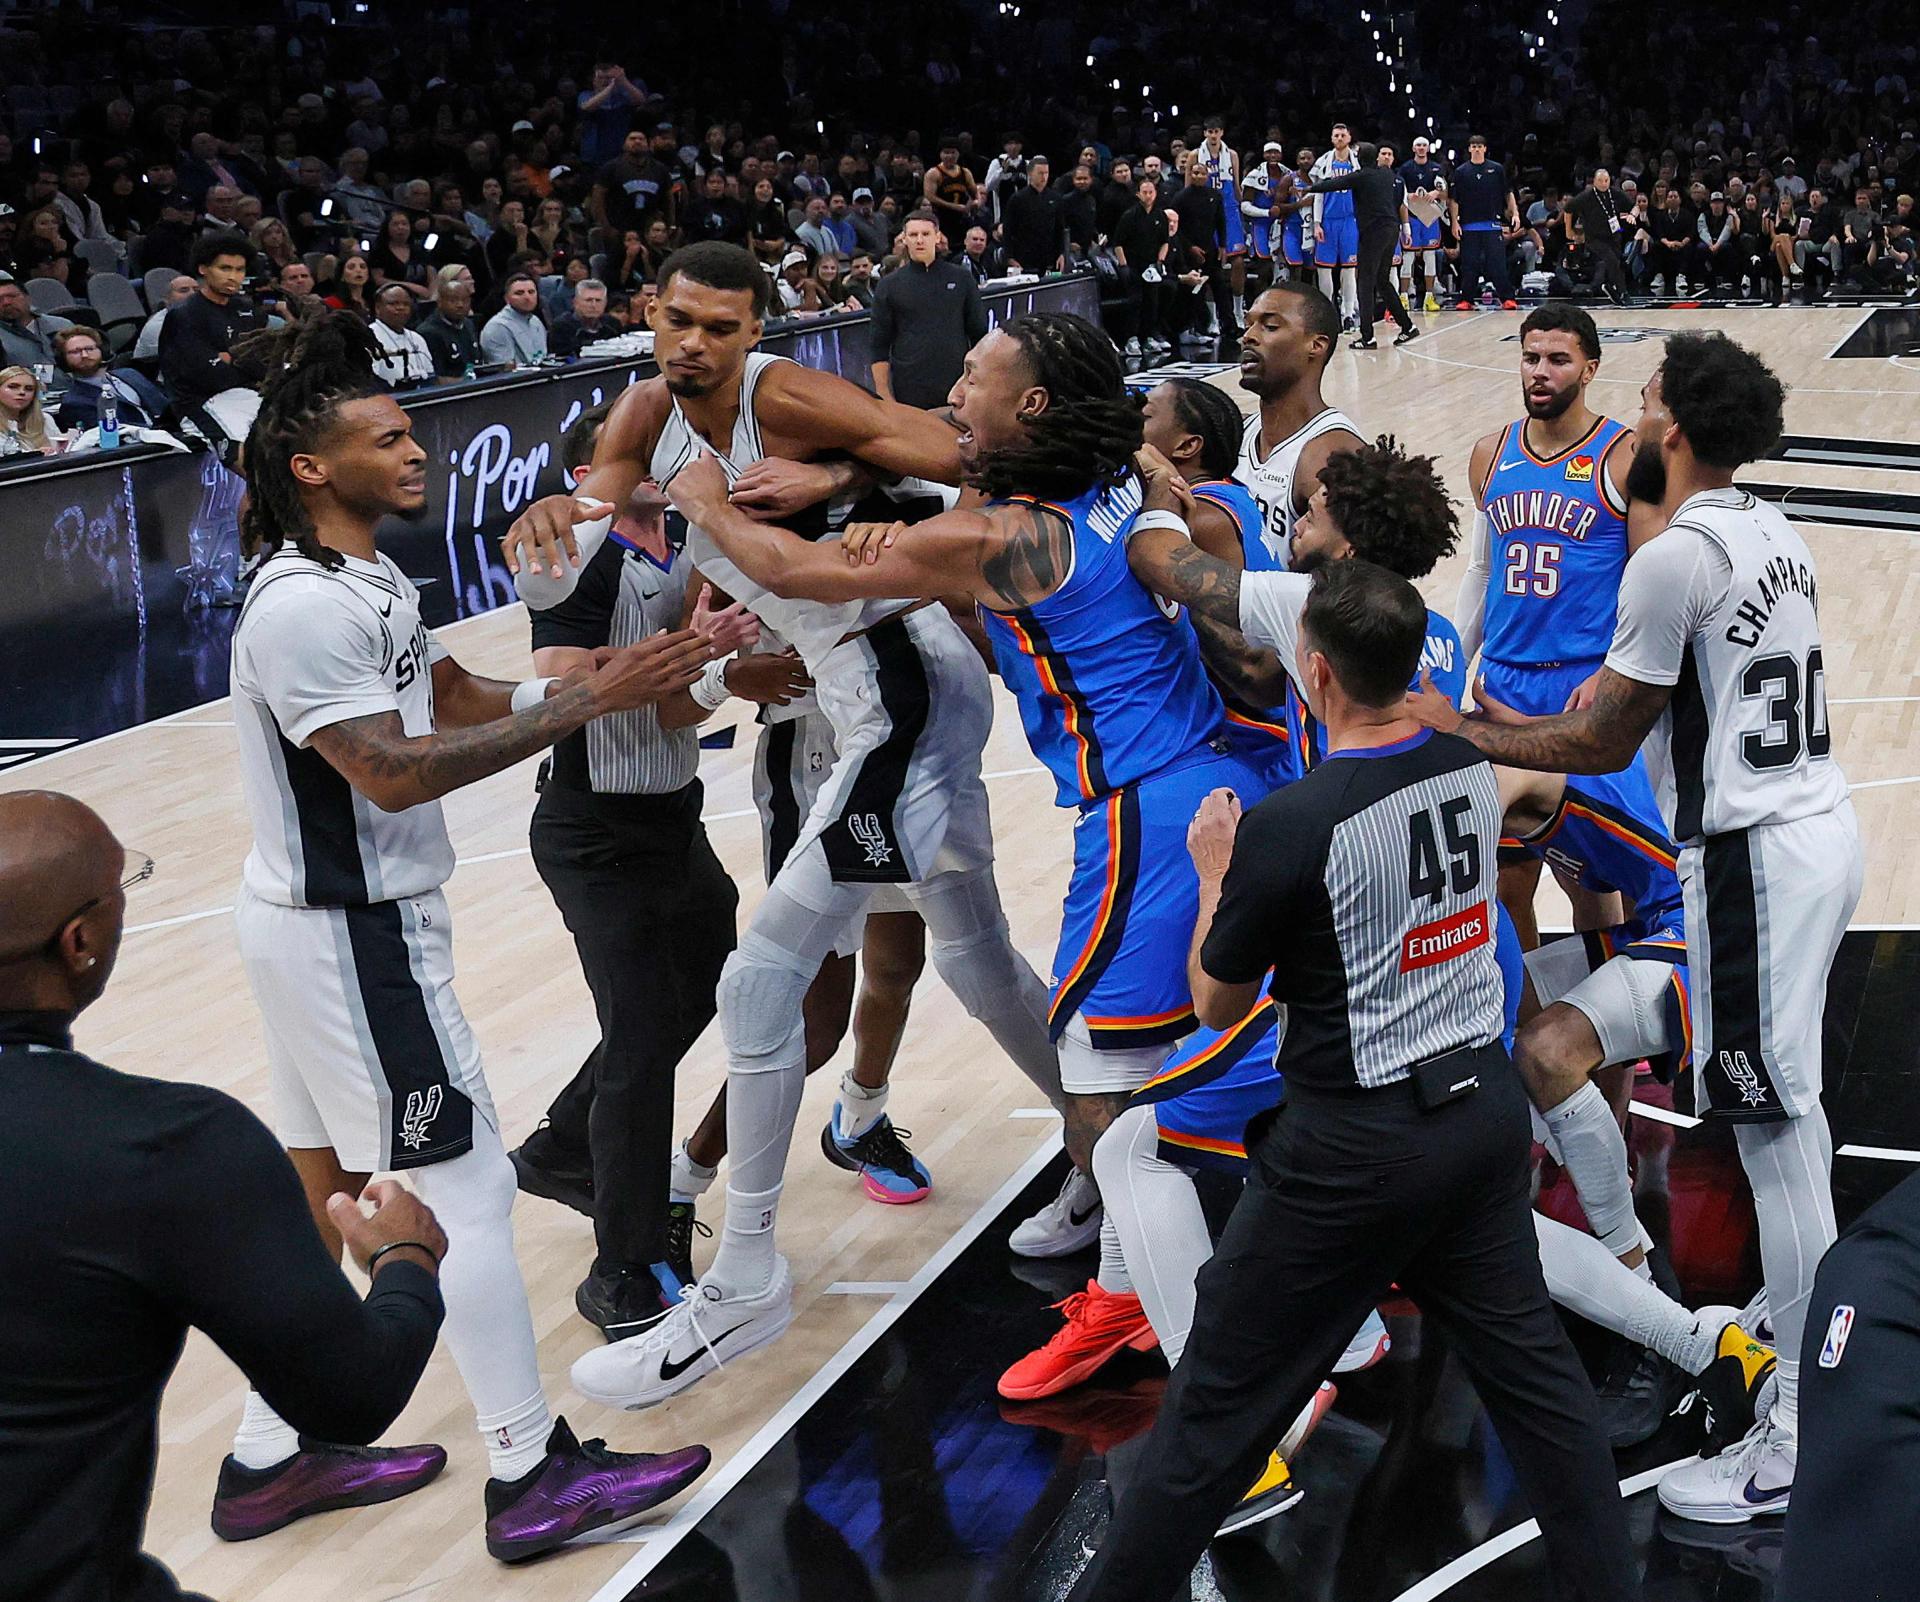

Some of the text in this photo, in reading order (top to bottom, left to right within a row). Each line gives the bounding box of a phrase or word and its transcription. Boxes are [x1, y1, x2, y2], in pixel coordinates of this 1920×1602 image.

[1264, 473, 1285, 483] LEDGER
[1486, 492, 1597, 541] THUNDER
[1505, 543, 1561, 598] 25
[1726, 556, 1820, 646] CHAMPAGN
[1739, 646, 1831, 774] 30
[1409, 794, 1480, 906] 45
[1408, 917, 1481, 959] Emirates
